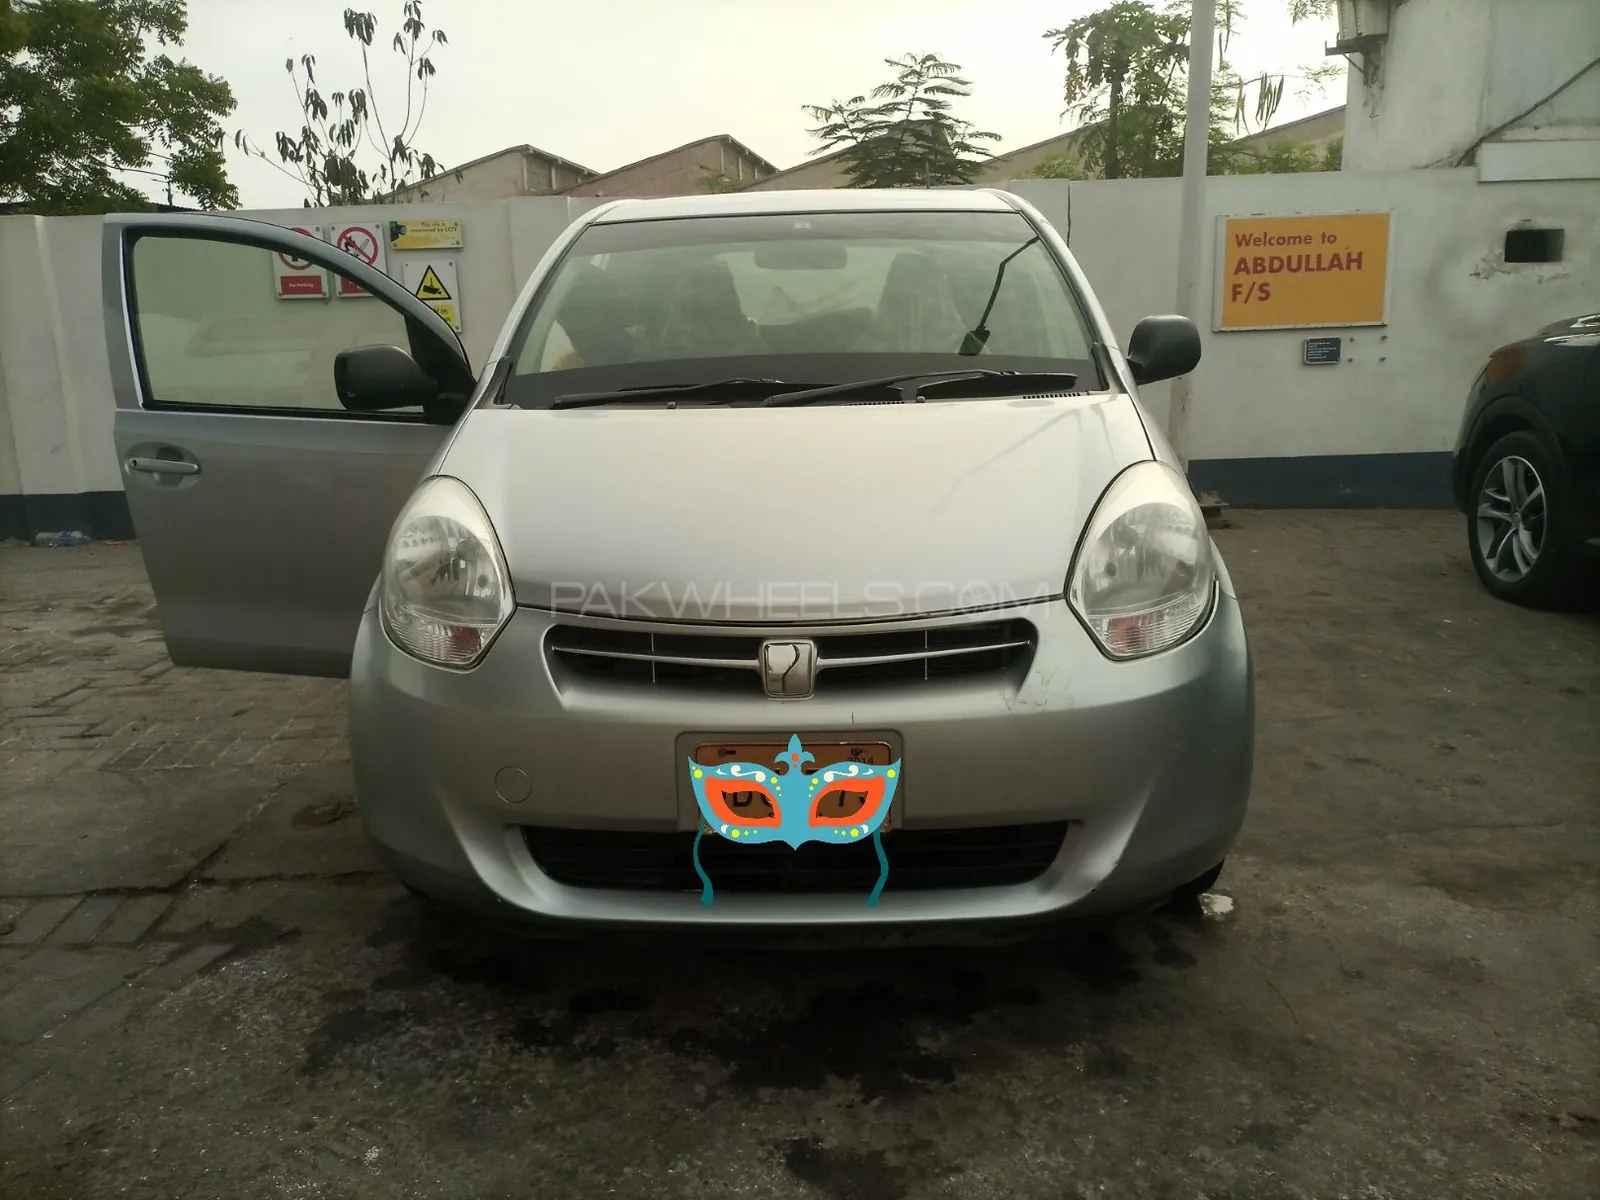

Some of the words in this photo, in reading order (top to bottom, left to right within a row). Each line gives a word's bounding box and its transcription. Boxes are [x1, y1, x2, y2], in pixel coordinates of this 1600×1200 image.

[1235, 231, 1313, 247] Welcome
[1321, 232, 1338, 244] to
[1233, 251, 1364, 275] ABDULLAH
[1231, 281, 1272, 304] F/S
